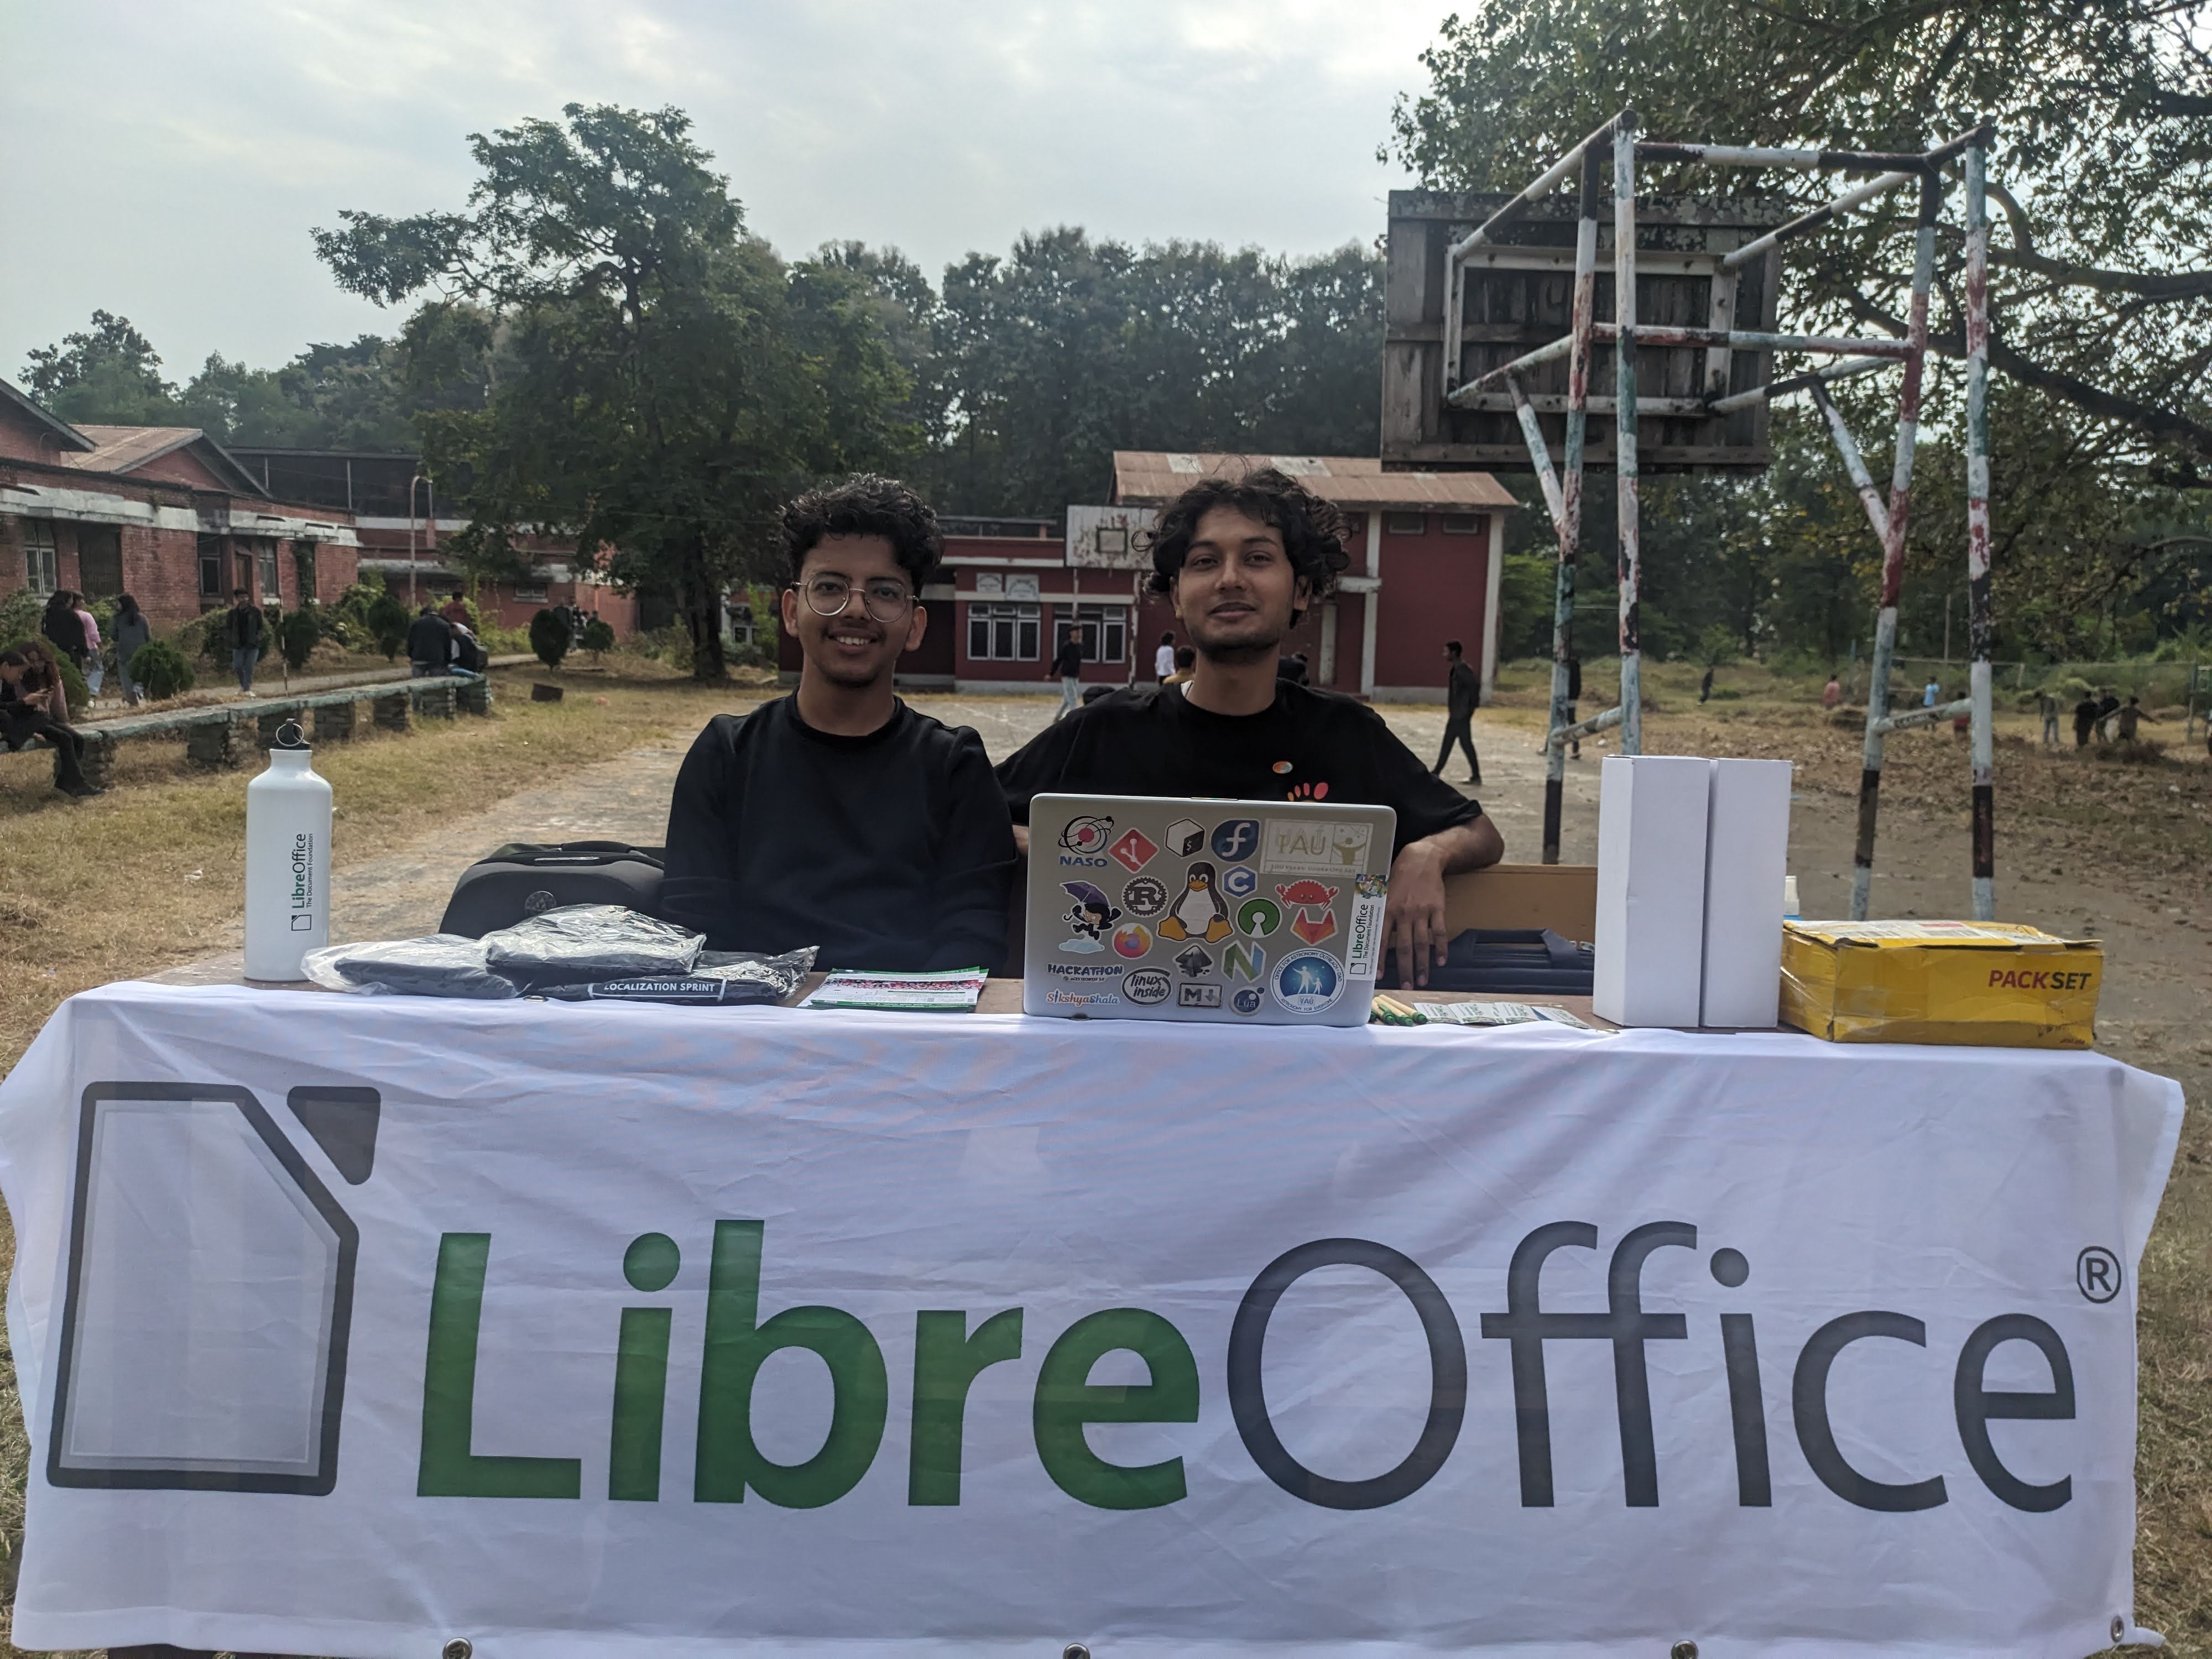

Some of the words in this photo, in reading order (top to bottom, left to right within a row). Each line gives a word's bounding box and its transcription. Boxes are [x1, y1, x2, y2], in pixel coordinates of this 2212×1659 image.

[1059, 856, 1108, 868] NASO
[291, 833, 306, 909] LibreOffice
[1228, 871, 1249, 893] C
[1352, 904, 1369, 959] LibreOffice
[1048, 964, 1123, 975] HACKATHON
[1274, 966, 1284, 980] OFFICE
[1282, 958, 1292, 968] FOR
[1290, 951, 1319, 960] ASTRONOMY
[1319, 953, 1339, 970] OUTREACH
[604, 982, 677, 992] LOCALIZATION
[680, 983, 715, 992] SPRINT
[1130, 974, 1162, 987] linux
[1988, 970, 2092, 990] PACKSET
[1047, 990, 1119, 1005] SikshyaShala
[1133, 987, 1165, 998] inside
[1237, 998, 1256, 1008] Lua
[1281, 998, 1302, 1011] ASTRONOMY
[1314, 998, 1333, 1011] EVERYONE
[417, 1219, 2075, 1513] LibreOffice
